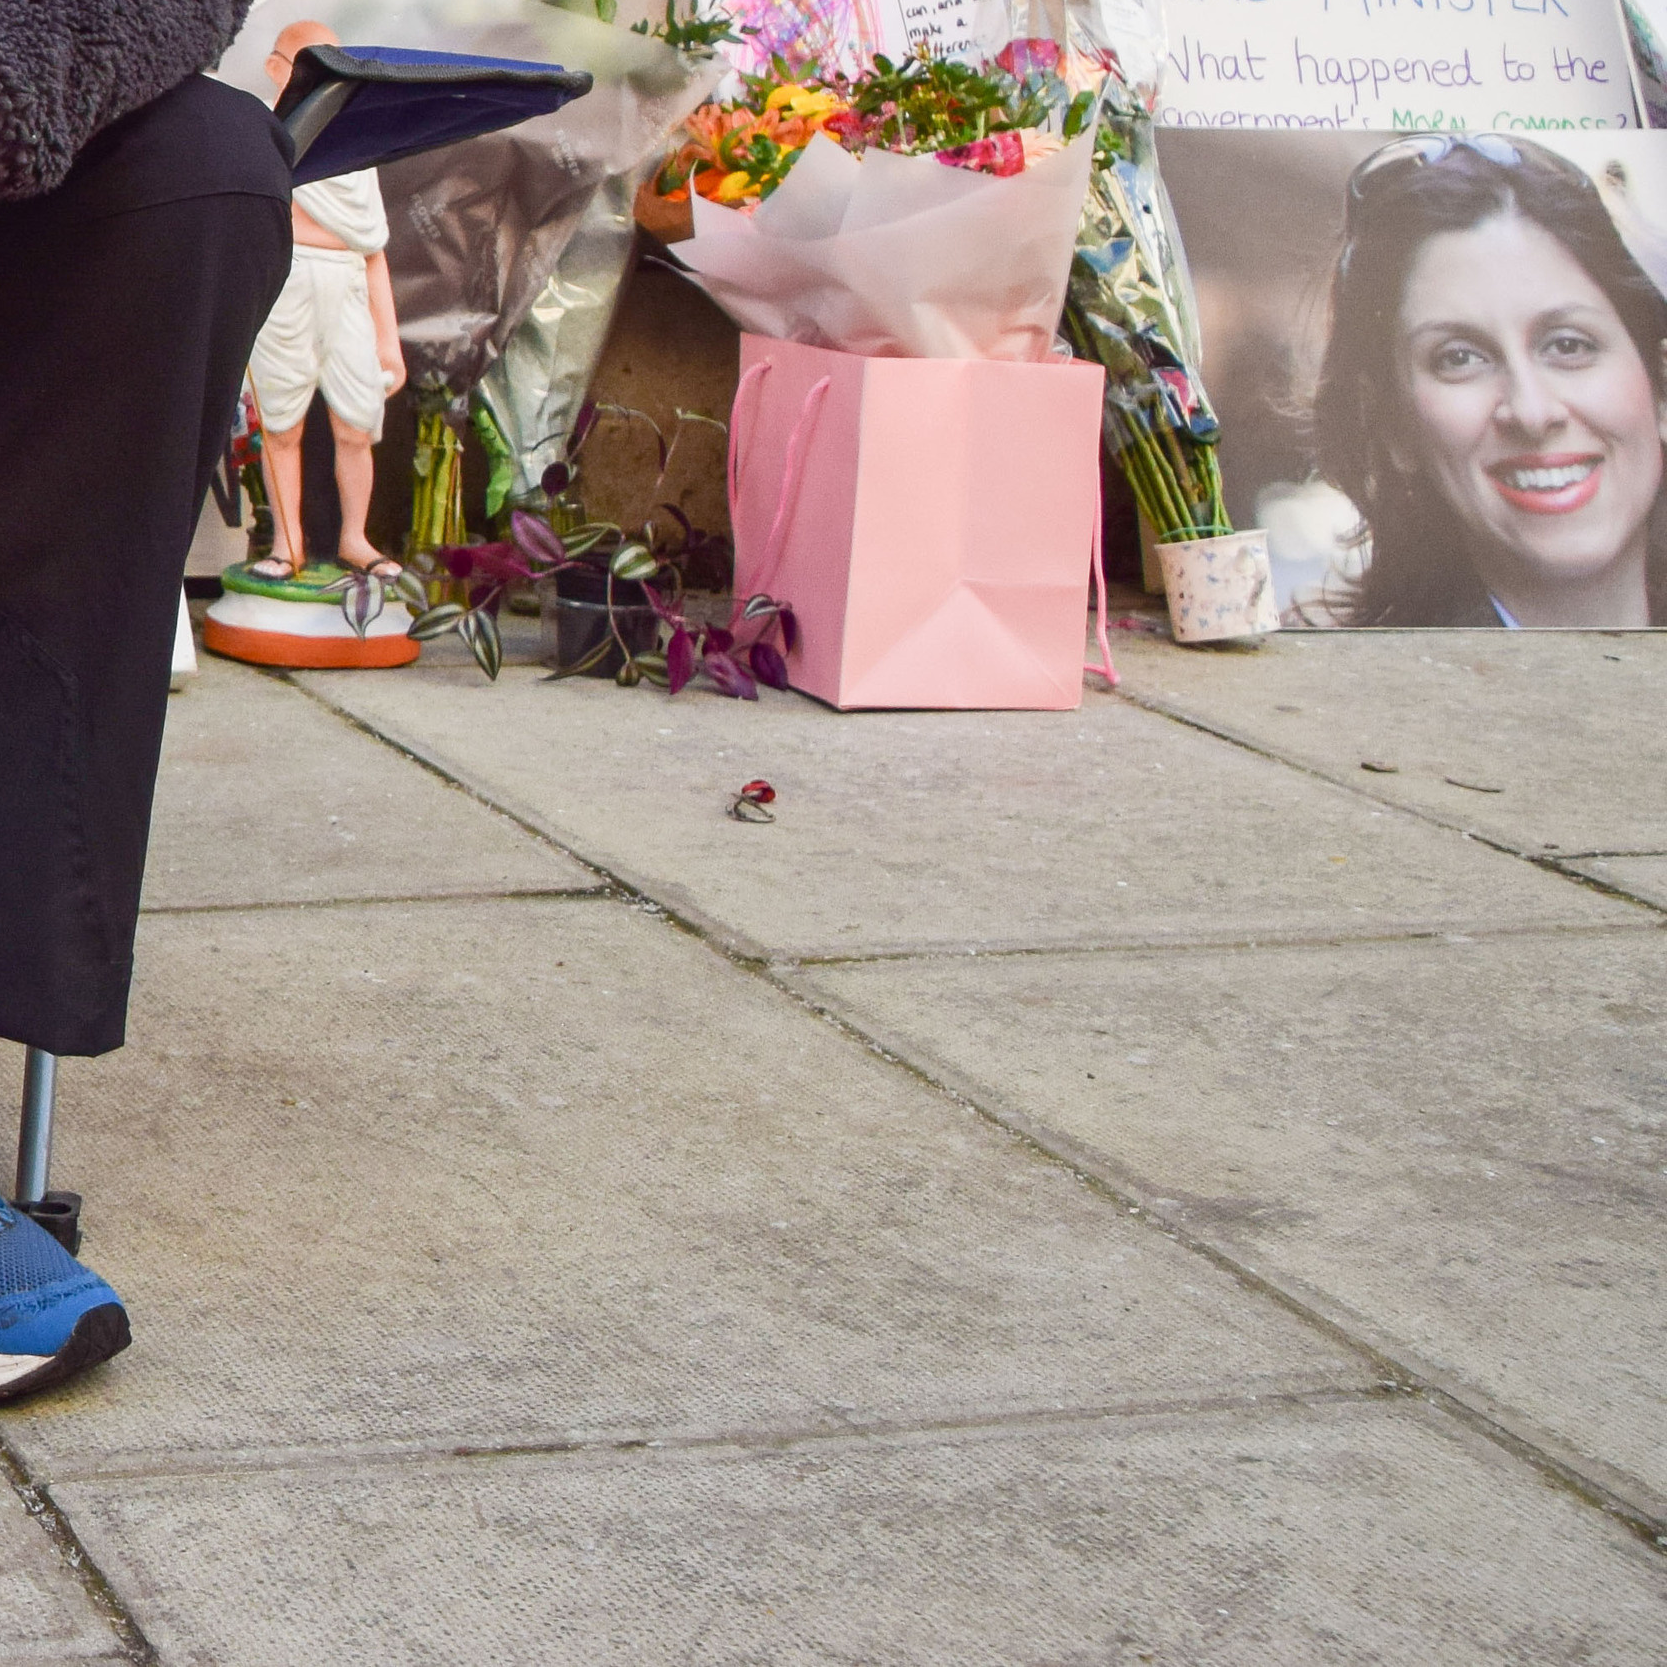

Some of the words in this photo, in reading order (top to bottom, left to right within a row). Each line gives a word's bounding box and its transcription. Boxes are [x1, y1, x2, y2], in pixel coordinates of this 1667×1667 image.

[909, 22, 943, 39] make
[956, 16, 968, 28] a
[1294, 35, 1484, 105] happened
[1503, 41, 1535, 83] to
[1553, 47, 1610, 85] the
